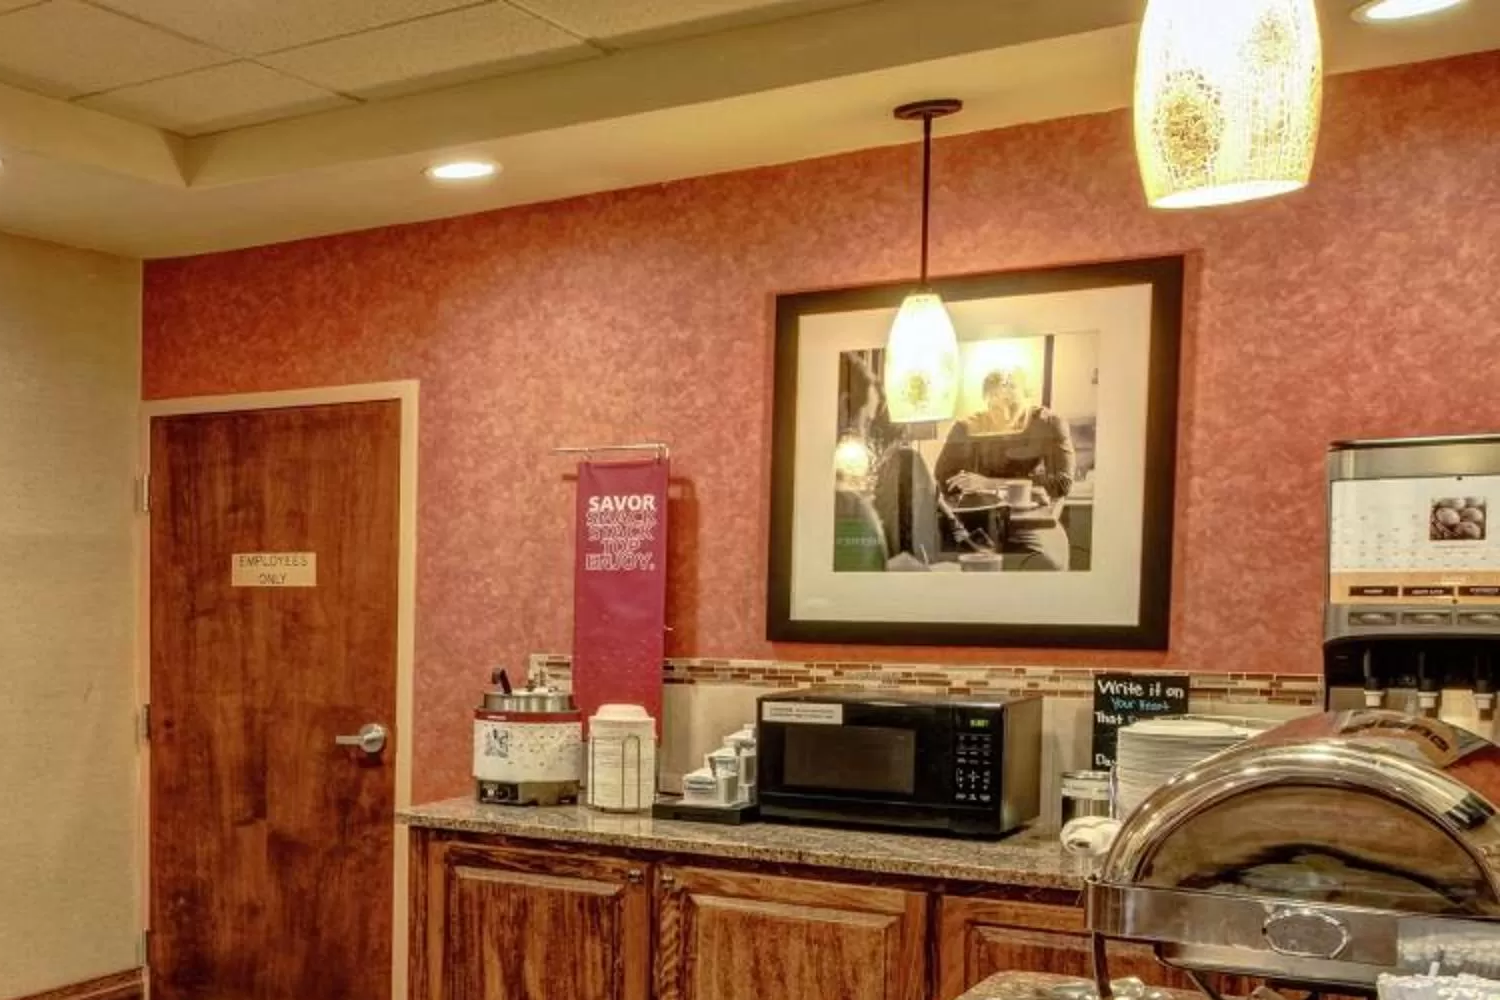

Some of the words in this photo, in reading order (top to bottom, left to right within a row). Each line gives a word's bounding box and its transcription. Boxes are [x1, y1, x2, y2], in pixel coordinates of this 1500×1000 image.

[588, 494, 656, 512] SAVOR
[239, 555, 309, 567] EMPLOYEES
[259, 572, 288, 584] ONLY
[1097, 679, 1144, 697] Write
[1149, 682, 1161, 697] it
[1166, 687, 1185, 698] on
[1094, 710, 1123, 725] That
